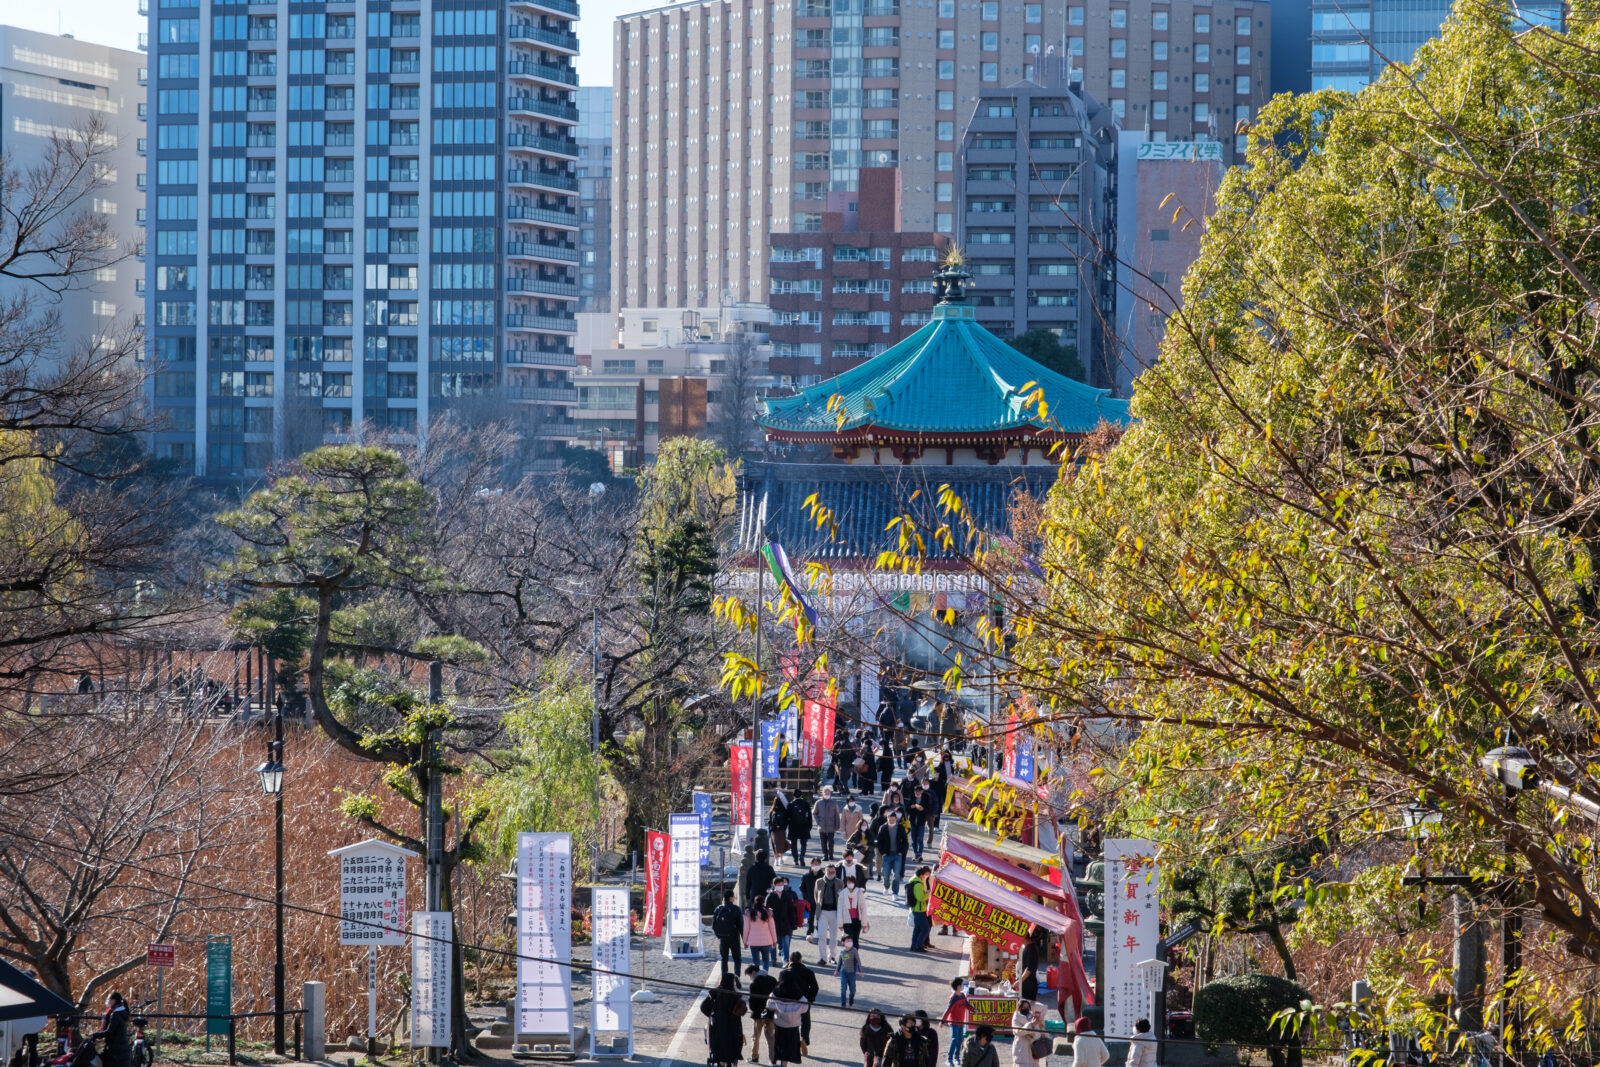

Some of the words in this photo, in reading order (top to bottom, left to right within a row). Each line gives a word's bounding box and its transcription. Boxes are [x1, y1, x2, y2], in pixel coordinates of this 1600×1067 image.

[1138, 143, 1218, 158] クミアイ化学
[767, 725, 776, 774] 谷中七福神
[700, 799, 709, 859] 谷中七福神
[384, 858, 392, 890] 令和三年
[397, 857, 405, 889] 令和三年
[933, 883, 988, 918] ISTANBUL
[988, 907, 1029, 937] KEBAB
[1123, 858, 1141, 953] 謹賀新年
[997, 1000, 1016, 1013] KEBAB
